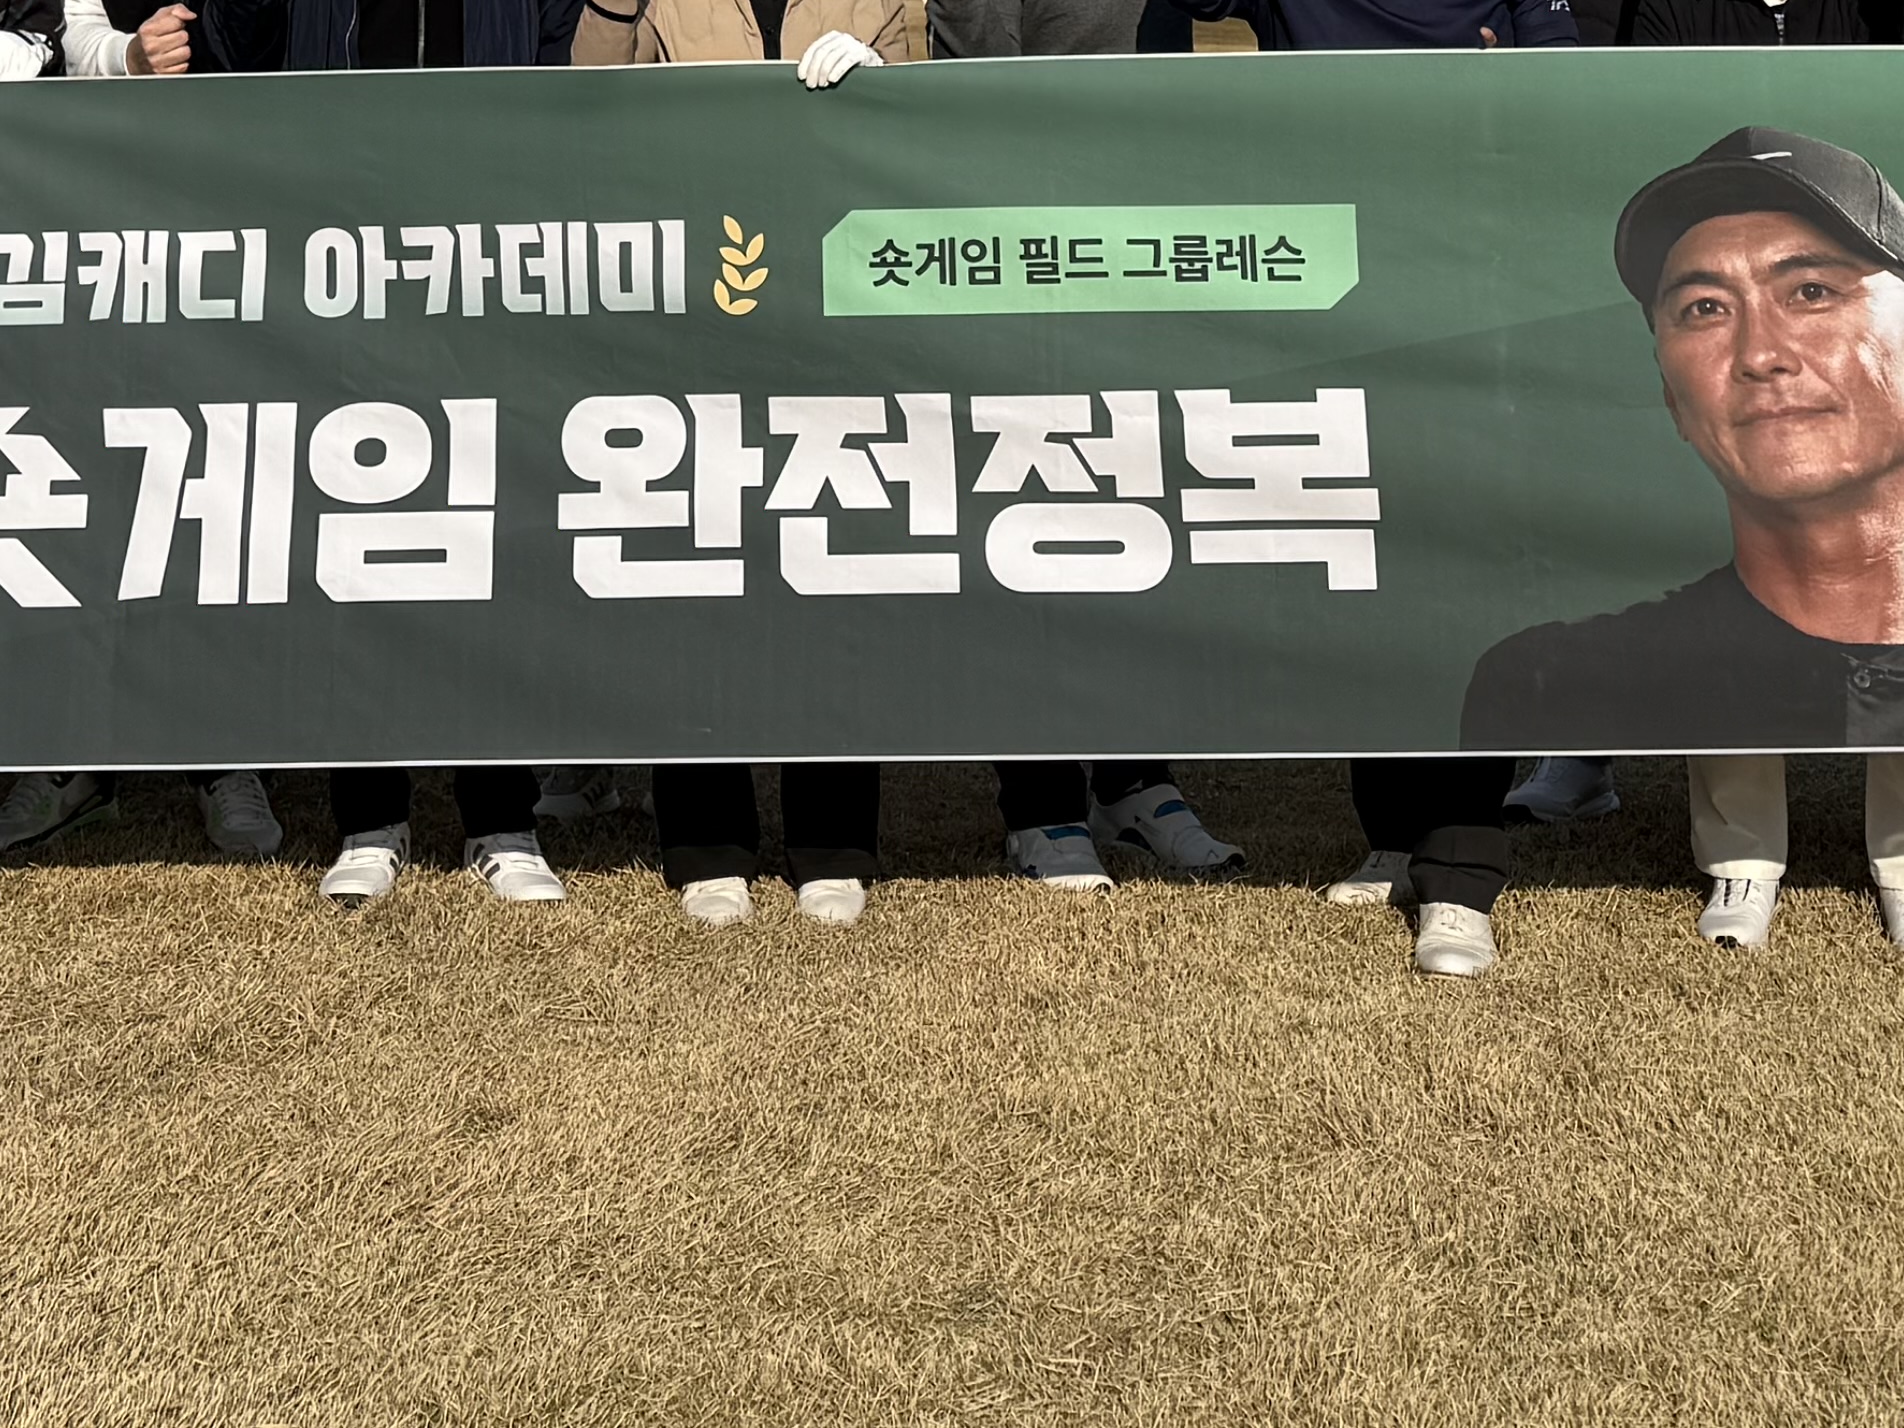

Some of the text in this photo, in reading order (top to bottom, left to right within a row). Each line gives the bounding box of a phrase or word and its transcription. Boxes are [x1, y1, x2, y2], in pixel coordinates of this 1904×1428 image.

[304, 220, 685, 319] 아카데미
[869, 234, 1306, 287] 숏게임 필드 그룹레슨
[558, 388, 1380, 598] 완전정복
